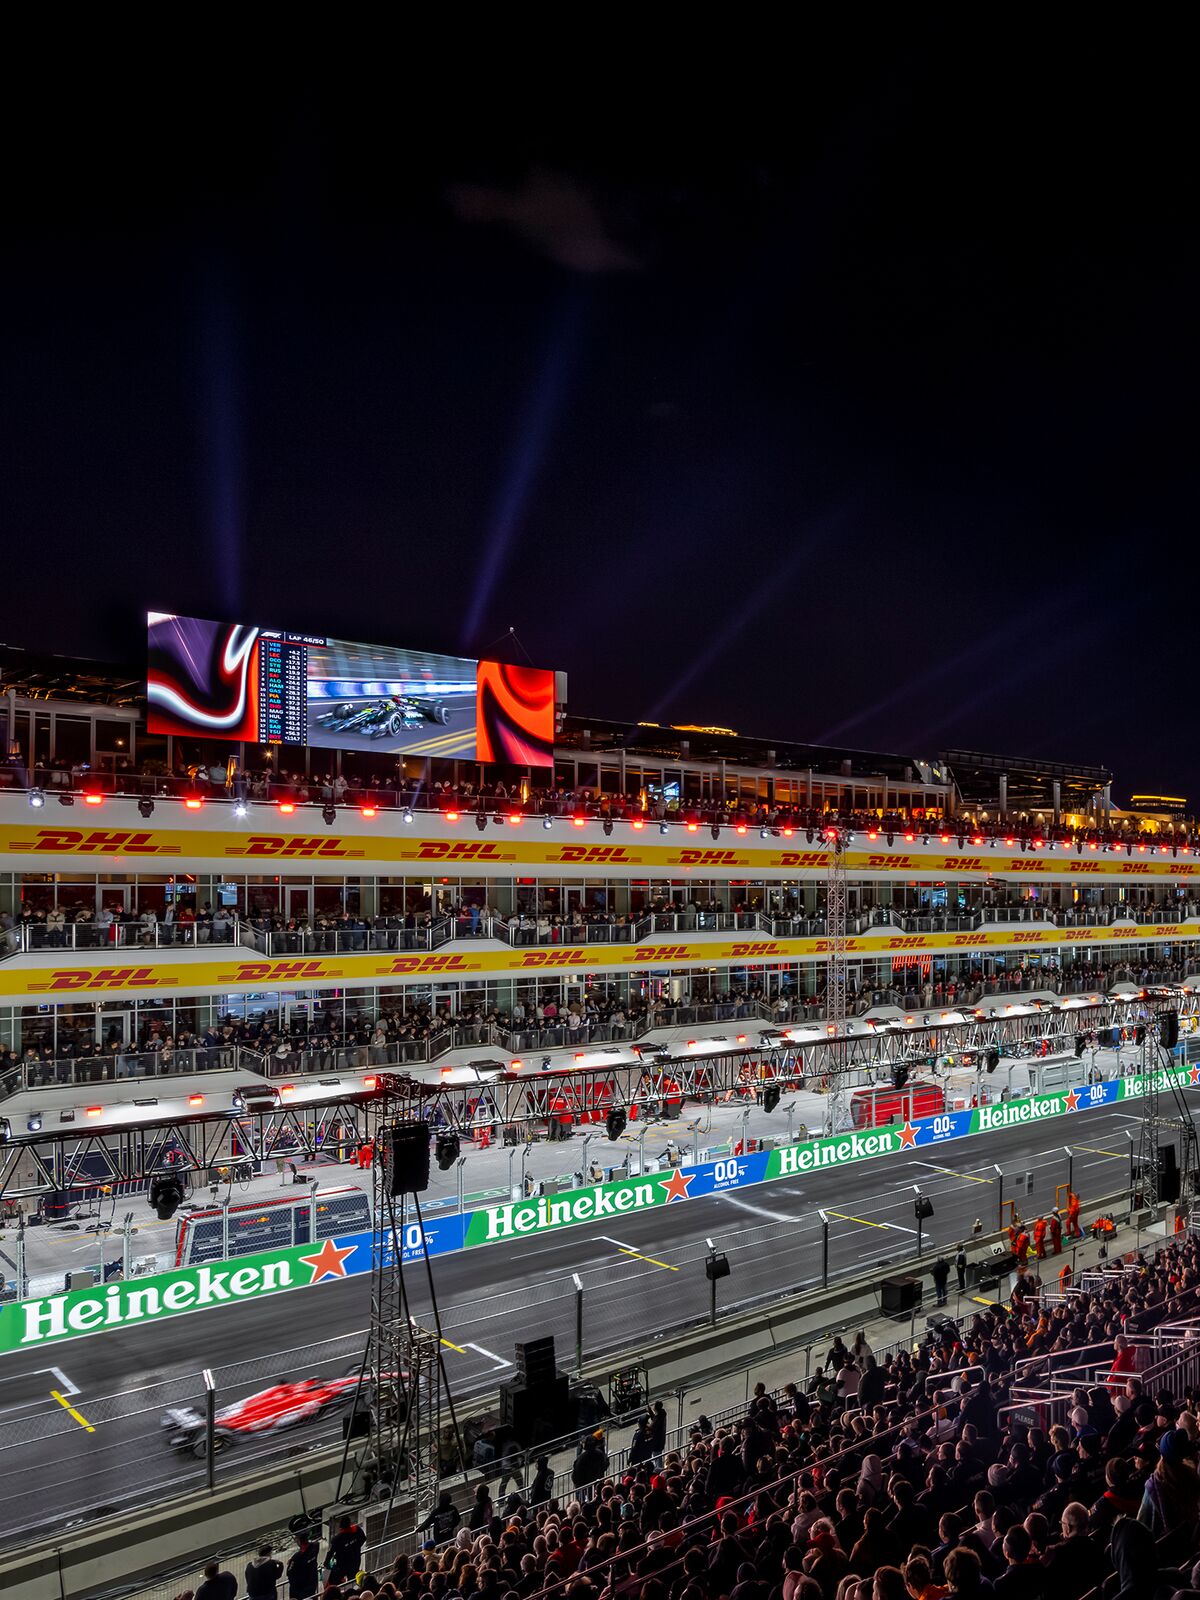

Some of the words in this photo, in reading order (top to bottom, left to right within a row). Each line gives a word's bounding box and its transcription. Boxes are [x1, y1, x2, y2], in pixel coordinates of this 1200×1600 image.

[35, 831, 160, 853] DHL
[246, 837, 348, 856] DHL
[416, 842, 503, 860] DHL
[560, 847, 630, 862] DHL
[679, 850, 739, 864] DHL
[780, 853, 830, 866] DHL
[868, 856, 912, 868] DHL
[944, 858, 984, 870] DHL
[1011, 860, 1045, 871] DHL
[1070, 862, 1100, 872] DHL
[1122, 864, 1150, 872] DHL
[954, 934, 987, 945] DHL
[1013, 932, 1044, 942] DHL
[1065, 930, 1093, 940] DHL
[815, 940, 858, 952] DHL
[889, 937, 927, 948] DHL
[634, 946, 691, 961] DHL
[730, 943, 781, 956] DHL
[390, 956, 470, 973] DHL
[522, 951, 587, 966] DHL
[235, 962, 329, 981] DHL
[50, 968, 160, 989] DHL
[978, 1098, 1060, 1130] Heineken
[778, 1128, 893, 1174] Heineken
[714, 1181, 730, 1189] ALCOHOL
[485, 1182, 656, 1240] Heineken
[412, 1249, 425, 1257] FREE
[20, 1259, 293, 1343] Heineken
[1014, 1413, 1034, 1426] PLEASE
